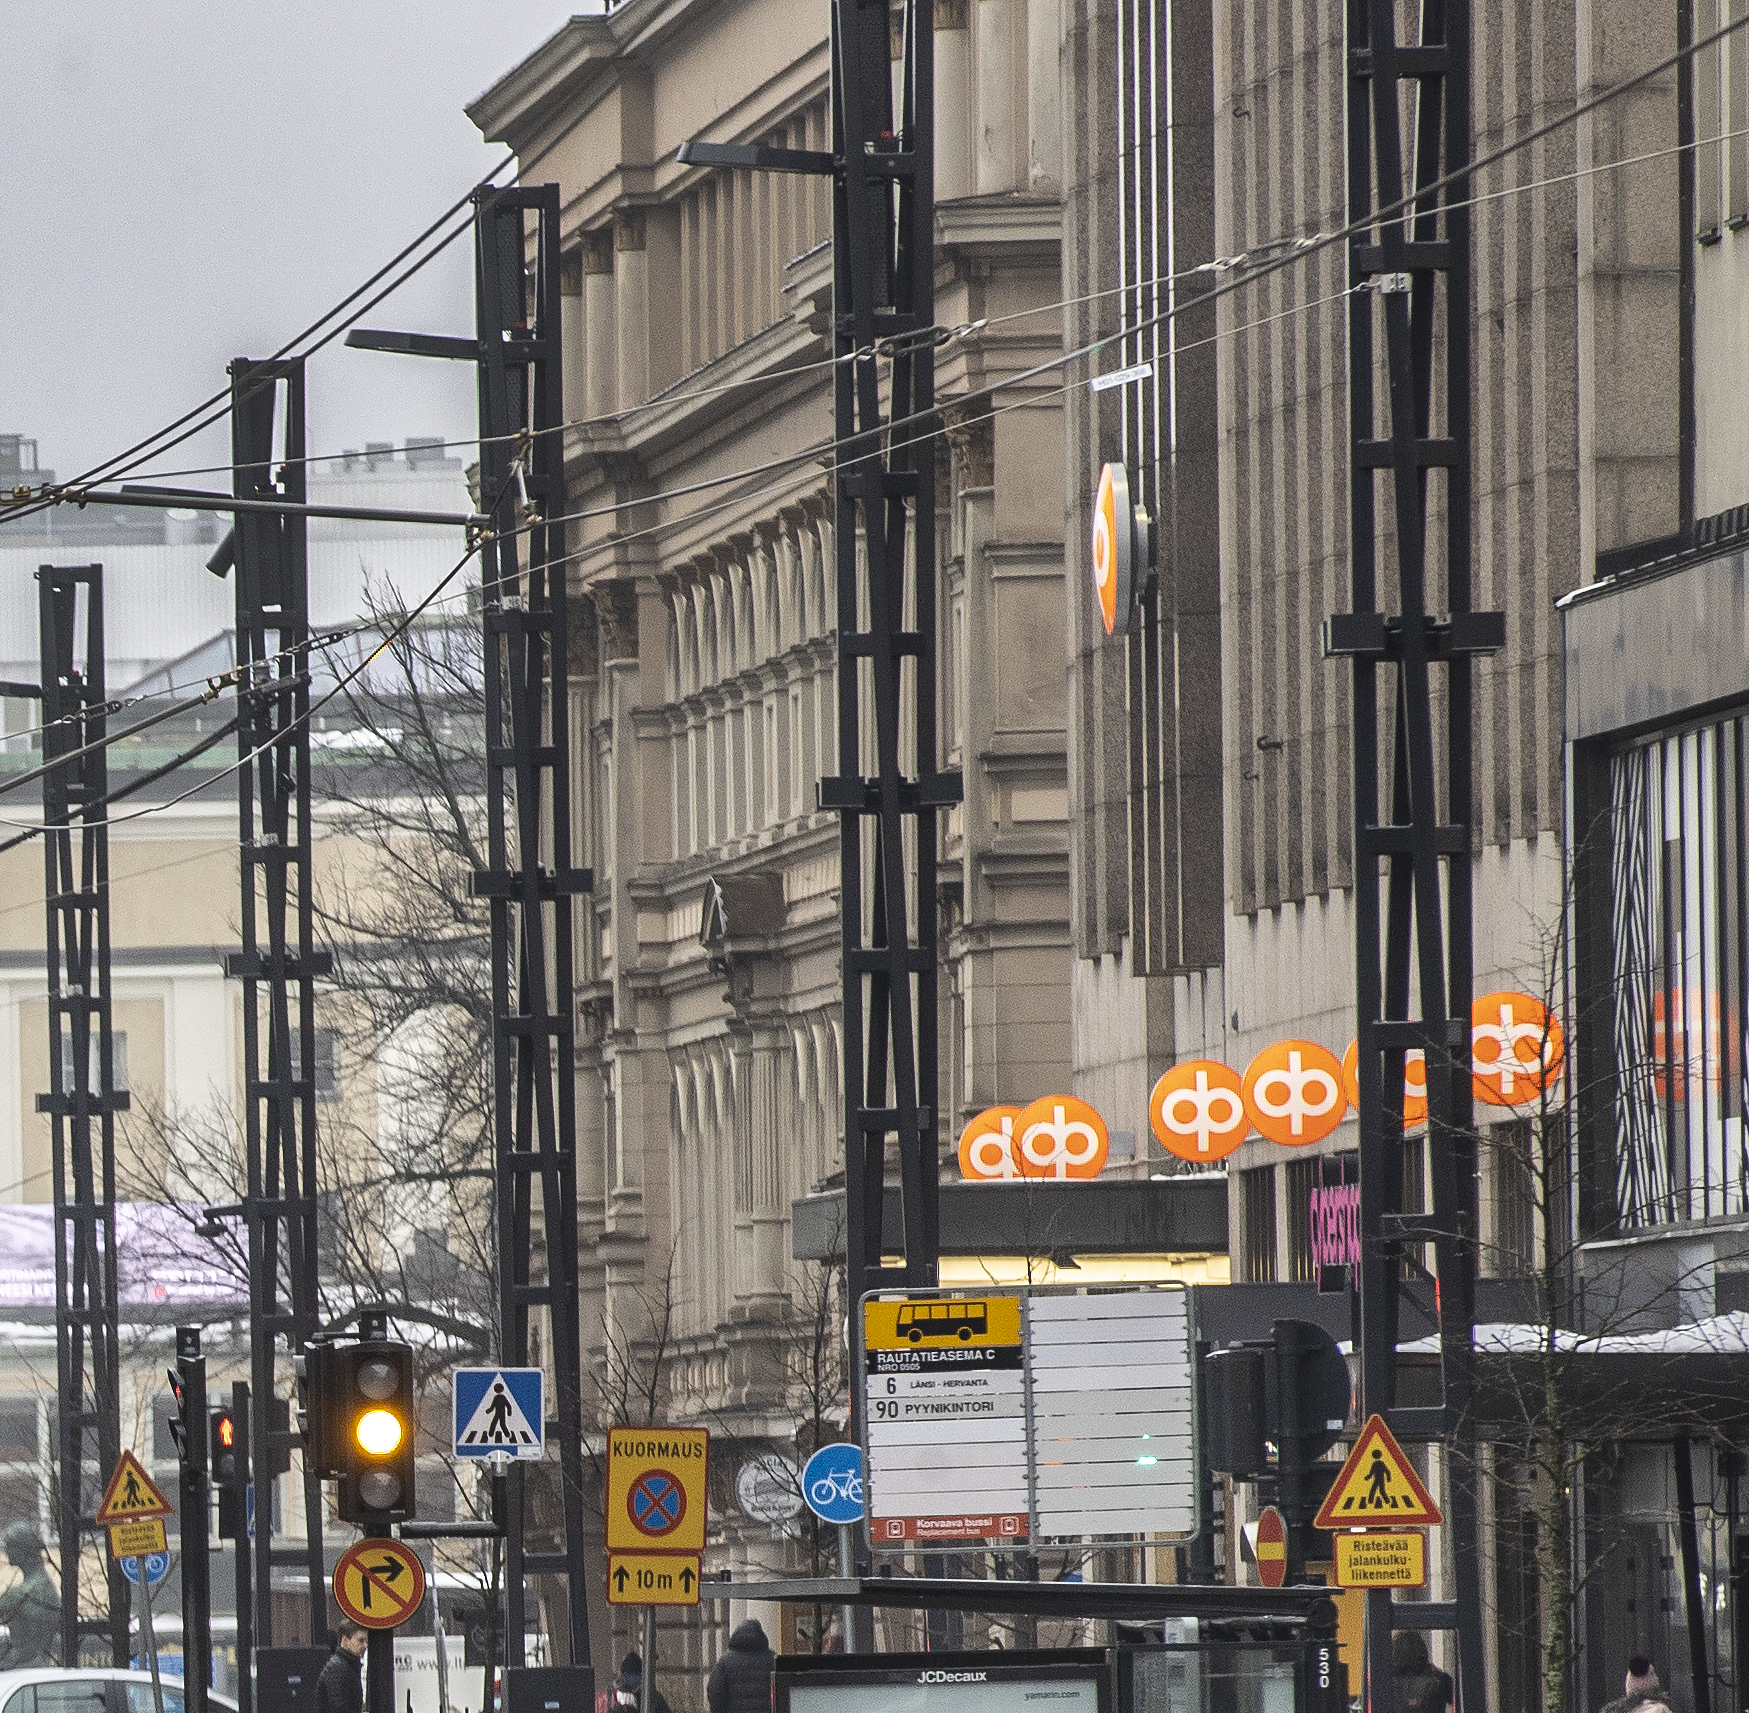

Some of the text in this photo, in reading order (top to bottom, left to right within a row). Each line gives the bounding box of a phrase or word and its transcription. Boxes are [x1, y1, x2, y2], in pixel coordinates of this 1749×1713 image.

[877, 1349, 996, 1364] RAUTATIEASEMA C
[877, 1364, 898, 1372] NRO
[886, 1377, 897, 1394] 6
[943, 1379, 989, 1388] HERVANTA
[876, 1401, 994, 1418] 90 PYYNIKINTORI
[613, 1441, 703, 1458] KUORMAUS
[1353, 1540, 1409, 1551] Risteävää
[1349, 1555, 1412, 1567] jalankulku-
[1351, 1569, 1412, 1580] liikennettä
[1318, 1648, 1330, 1688] 530
[917, 1669, 988, 1684] JCDecaux
